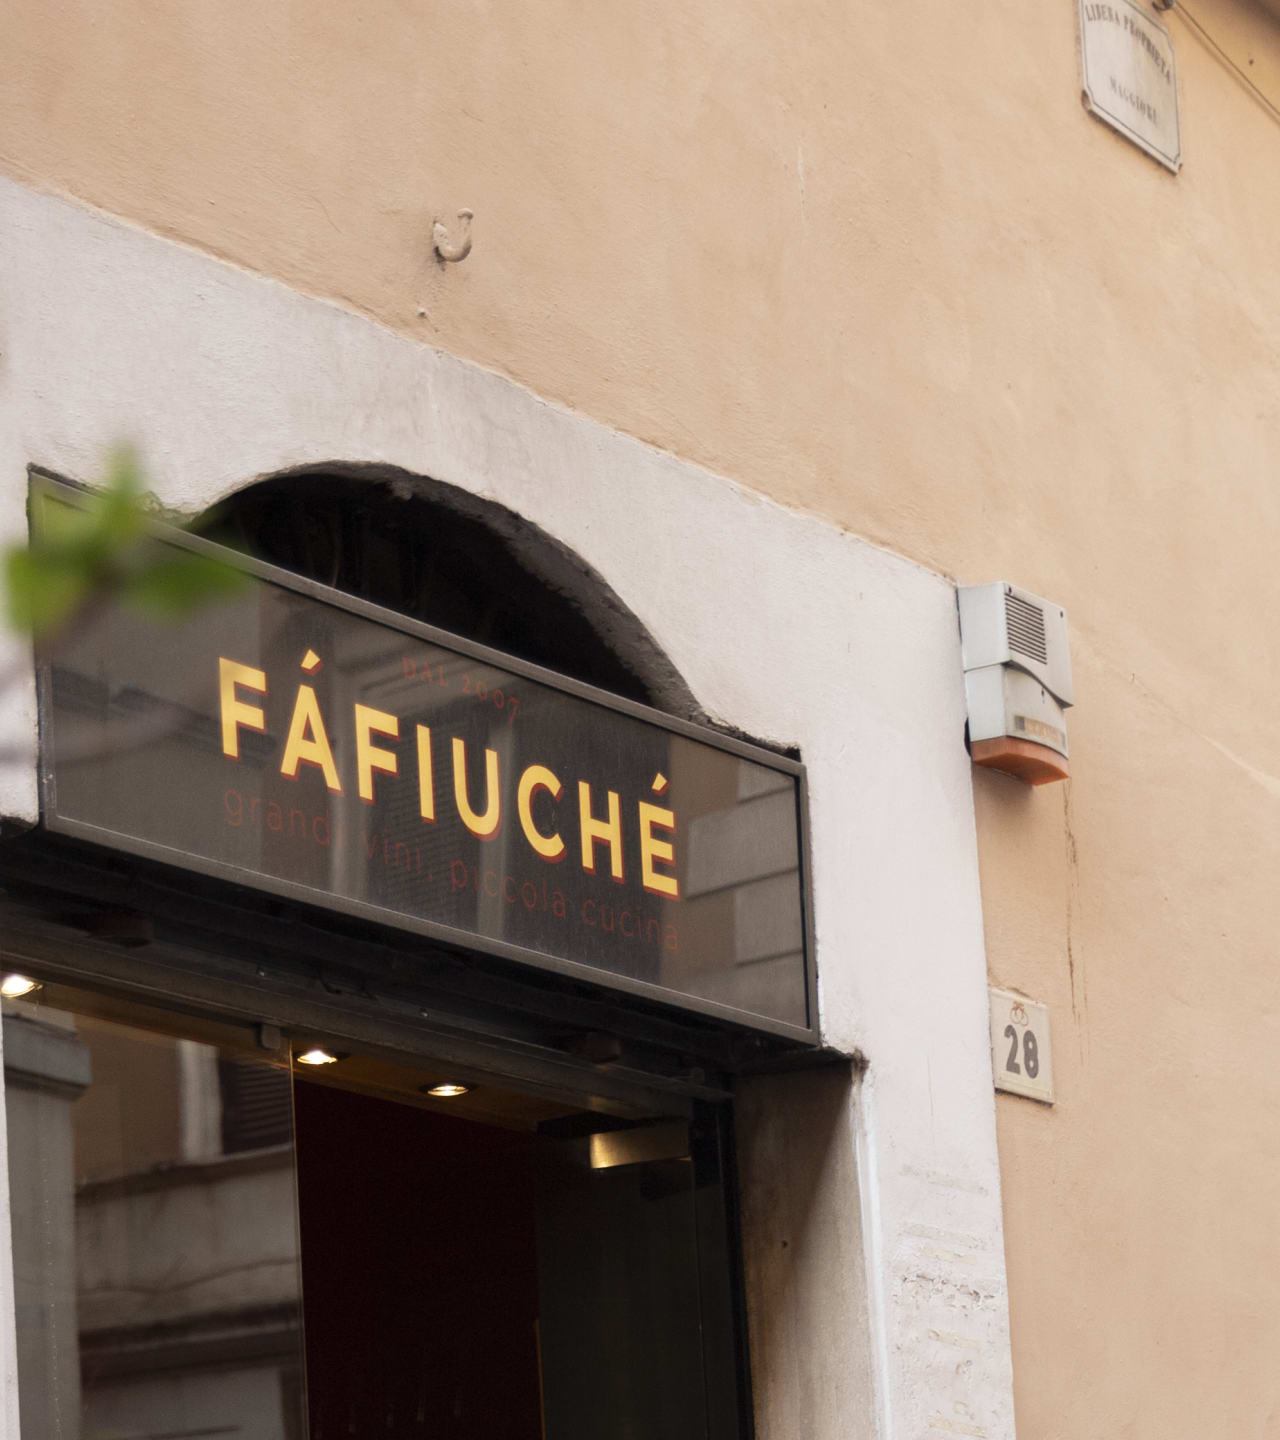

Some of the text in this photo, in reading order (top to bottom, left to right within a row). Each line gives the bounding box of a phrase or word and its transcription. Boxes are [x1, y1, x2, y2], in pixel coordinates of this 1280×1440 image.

[402, 656, 519, 724] DAL 2007
[218, 649, 681, 899] FÁFIUCHÉ
[450, 859, 567, 918] piccola
[583, 899, 679, 950] cucina
[1004, 1024, 1039, 1079] 28
